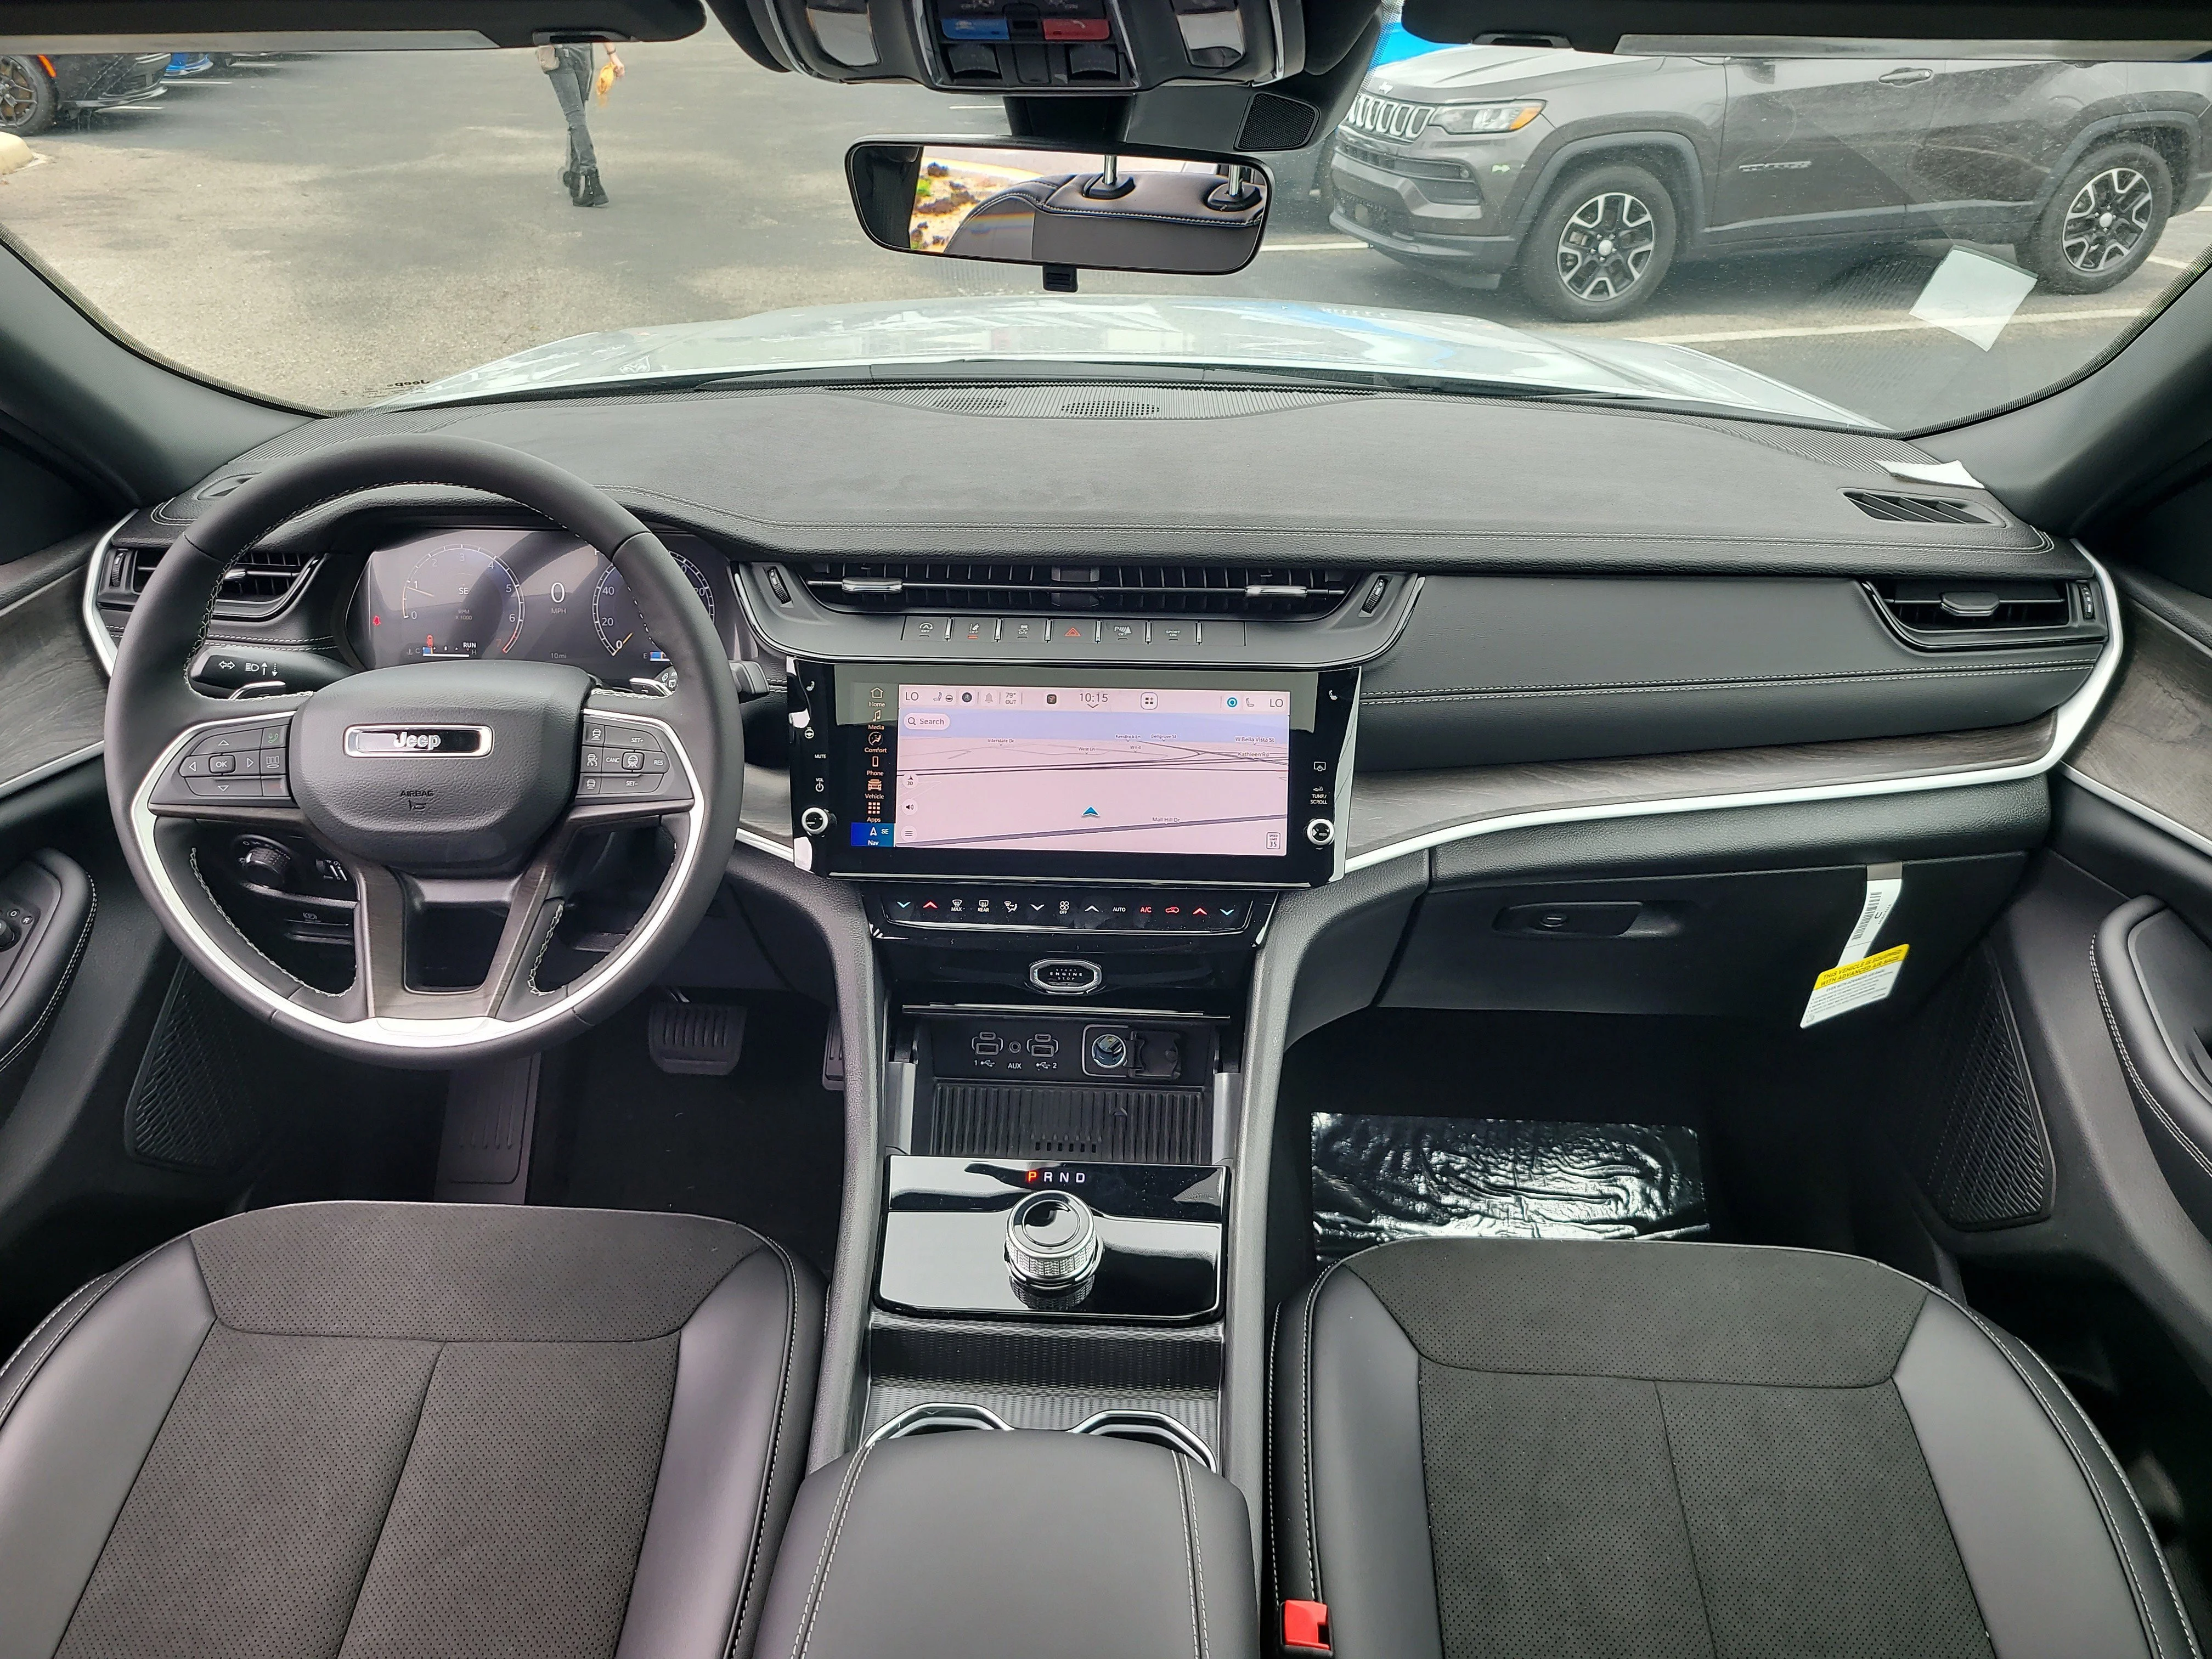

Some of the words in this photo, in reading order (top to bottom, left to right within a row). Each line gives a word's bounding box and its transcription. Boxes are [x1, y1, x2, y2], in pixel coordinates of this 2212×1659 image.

[459, 553, 465, 561] 3
[506, 584, 512, 592] 5
[551, 582, 565, 603] 0
[602, 586, 614, 595] 40
[411, 611, 417, 619] 0
[509, 614, 515, 622] 6
[602, 618, 613, 626] 20
[616, 640, 622, 649] 0
[905, 692, 919, 701] LO
[1080, 693, 1108, 702] 10:15
[1269, 698, 1283, 708] LO
[393, 732, 441, 751] Jeep
[1824, 970, 1837, 979] THIS
[1838, 963, 1864, 974] VEHICLE
[1821, 978, 1837, 986] WITH
[1838, 966, 1871, 980] ADVANCED
[1028, 1171, 1036, 1181] P
[1044, 1172, 1053, 1182] R
[1059, 1172, 1069, 1182] N
[1076, 1172, 1085, 1183] D
